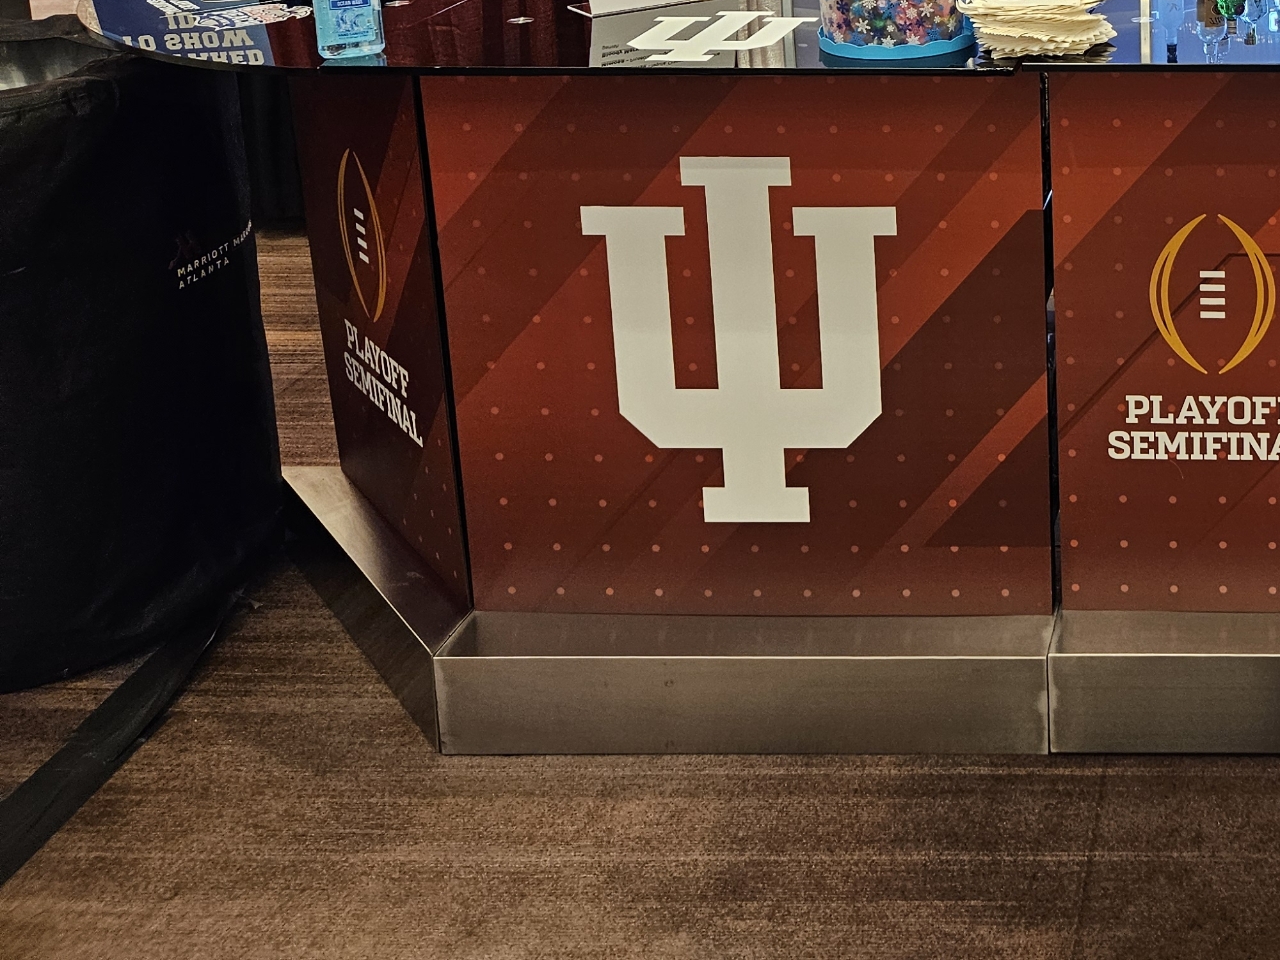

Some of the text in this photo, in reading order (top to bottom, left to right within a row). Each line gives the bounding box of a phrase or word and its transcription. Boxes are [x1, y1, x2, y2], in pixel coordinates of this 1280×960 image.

[177, 242, 229, 278] MARRIOTT
[178, 256, 230, 290] ATLANTA
[343, 318, 409, 399] PLAYOFF
[343, 351, 424, 448] SEMIFINAL
